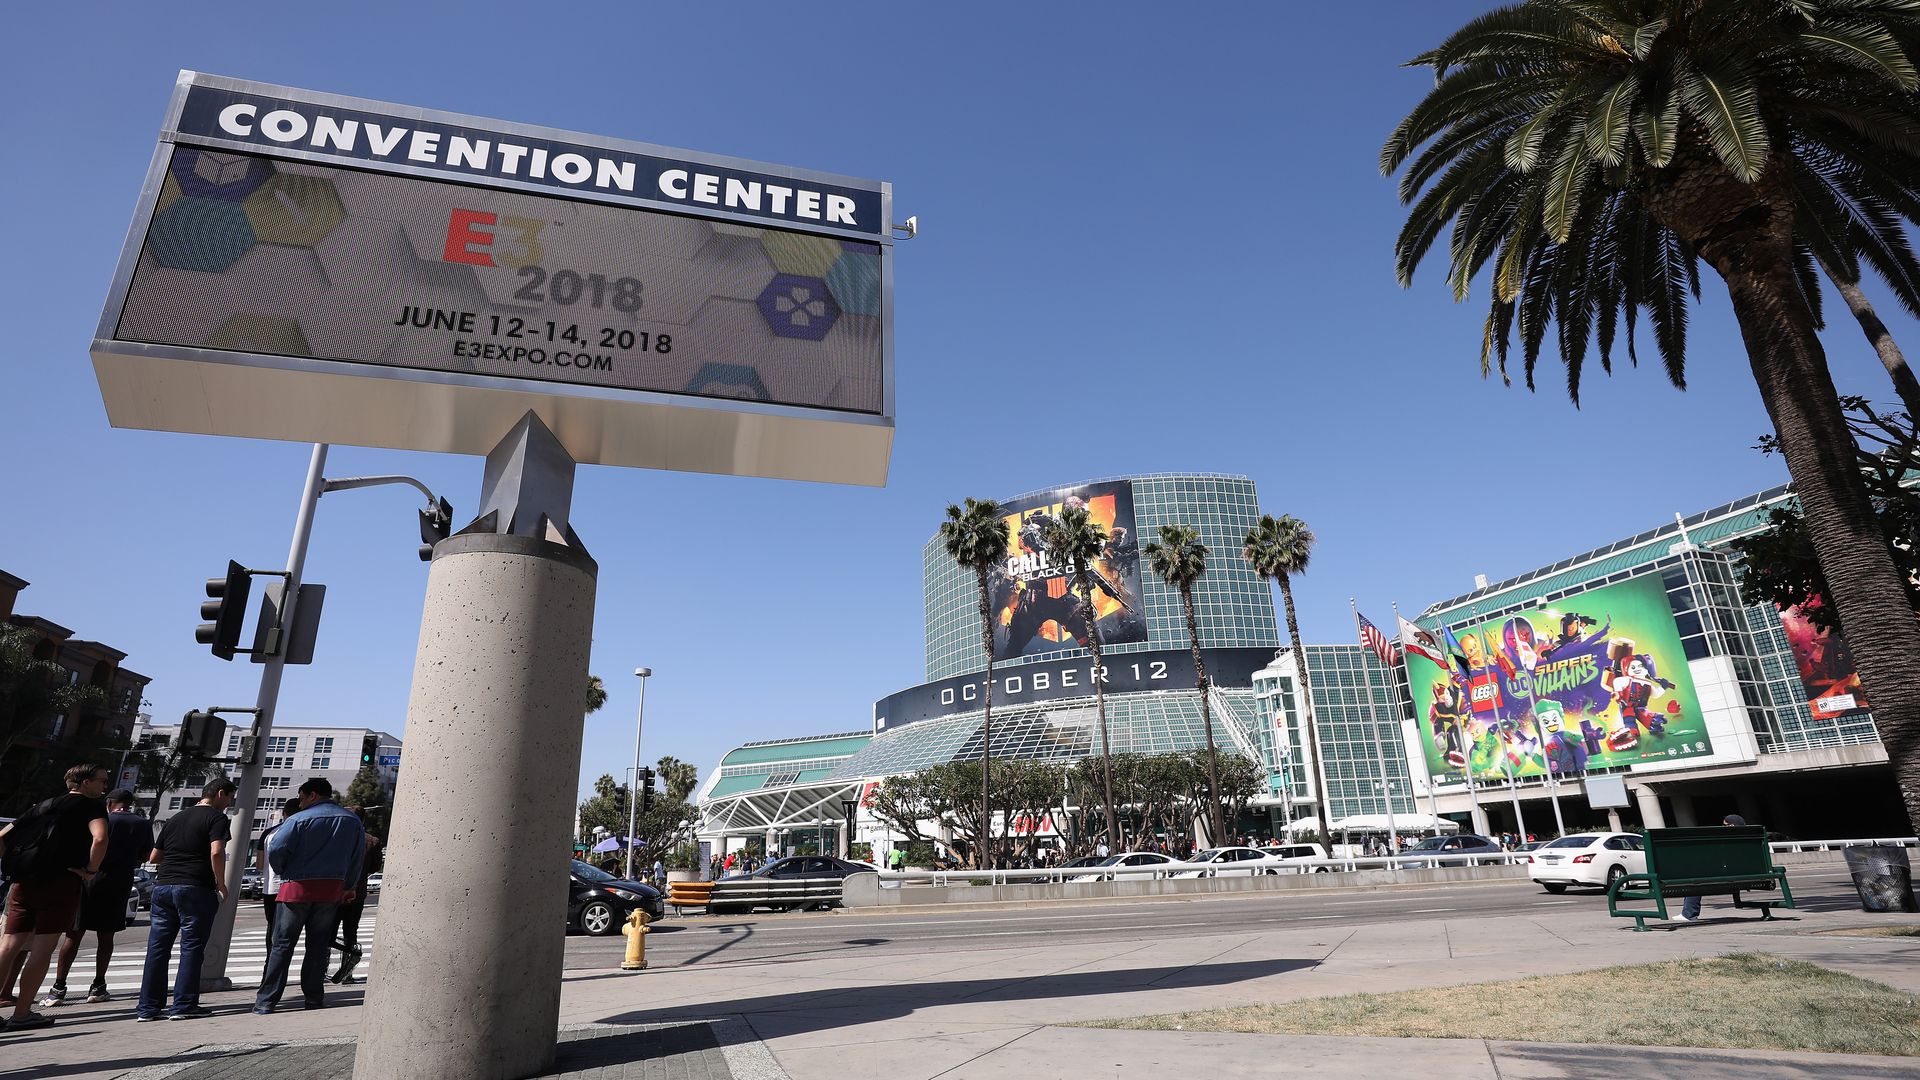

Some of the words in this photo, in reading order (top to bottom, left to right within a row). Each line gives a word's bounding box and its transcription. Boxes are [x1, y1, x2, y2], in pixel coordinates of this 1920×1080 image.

[218, 103, 636, 191] CONVENTION
[658, 169, 858, 226] CENTER
[442, 207, 545, 269] E3
[513, 265, 644, 313] 2018
[395, 305, 476, 334] JUNE
[490, 315, 588, 348] 12-14,
[599, 327, 673, 354] 2018
[453, 340, 613, 371] E3EXPO.COM
[1007, 550, 1050, 577] CALL
[1022, 566, 1063, 582] BLACK
[1130, 660, 1168, 681] 12
[1472, 682, 1499, 702] LEGO
[1533, 660, 1599, 697] VILLAINS
[1819, 701, 1828, 709] RP
